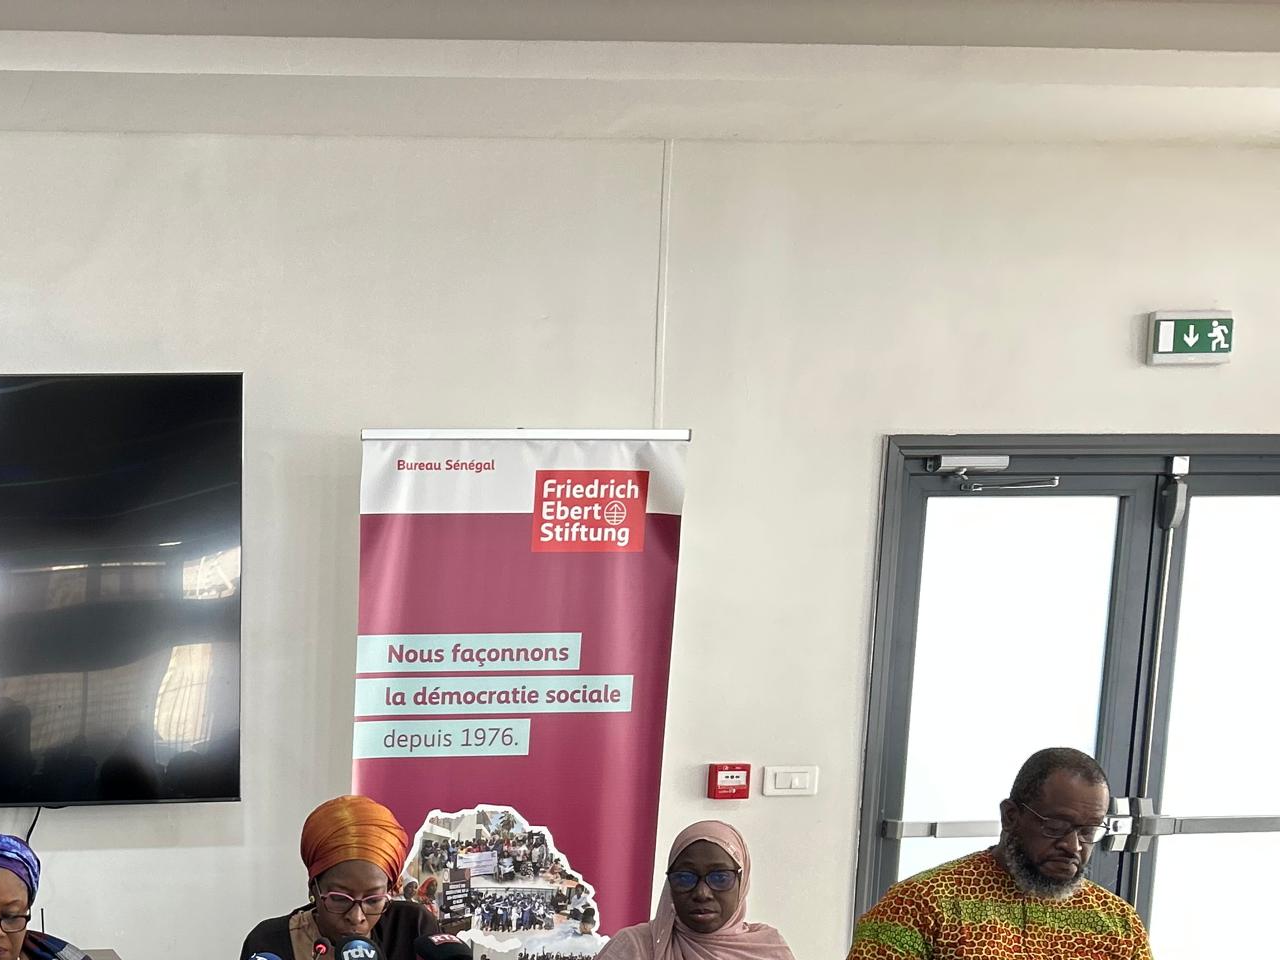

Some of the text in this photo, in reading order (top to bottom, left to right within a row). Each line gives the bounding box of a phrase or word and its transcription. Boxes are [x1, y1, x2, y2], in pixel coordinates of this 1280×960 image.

[397, 458, 495, 473] Bureau Sénégal
[543, 479, 639, 499] Friedrich
[542, 501, 601, 520] Ebert
[540, 522, 630, 546] Stiftung
[387, 643, 569, 667] Nous façonnons
[385, 684, 621, 706] la démocratie sociale
[383, 728, 519, 752] depuis 1976.
[343, 945, 376, 960] rdv
